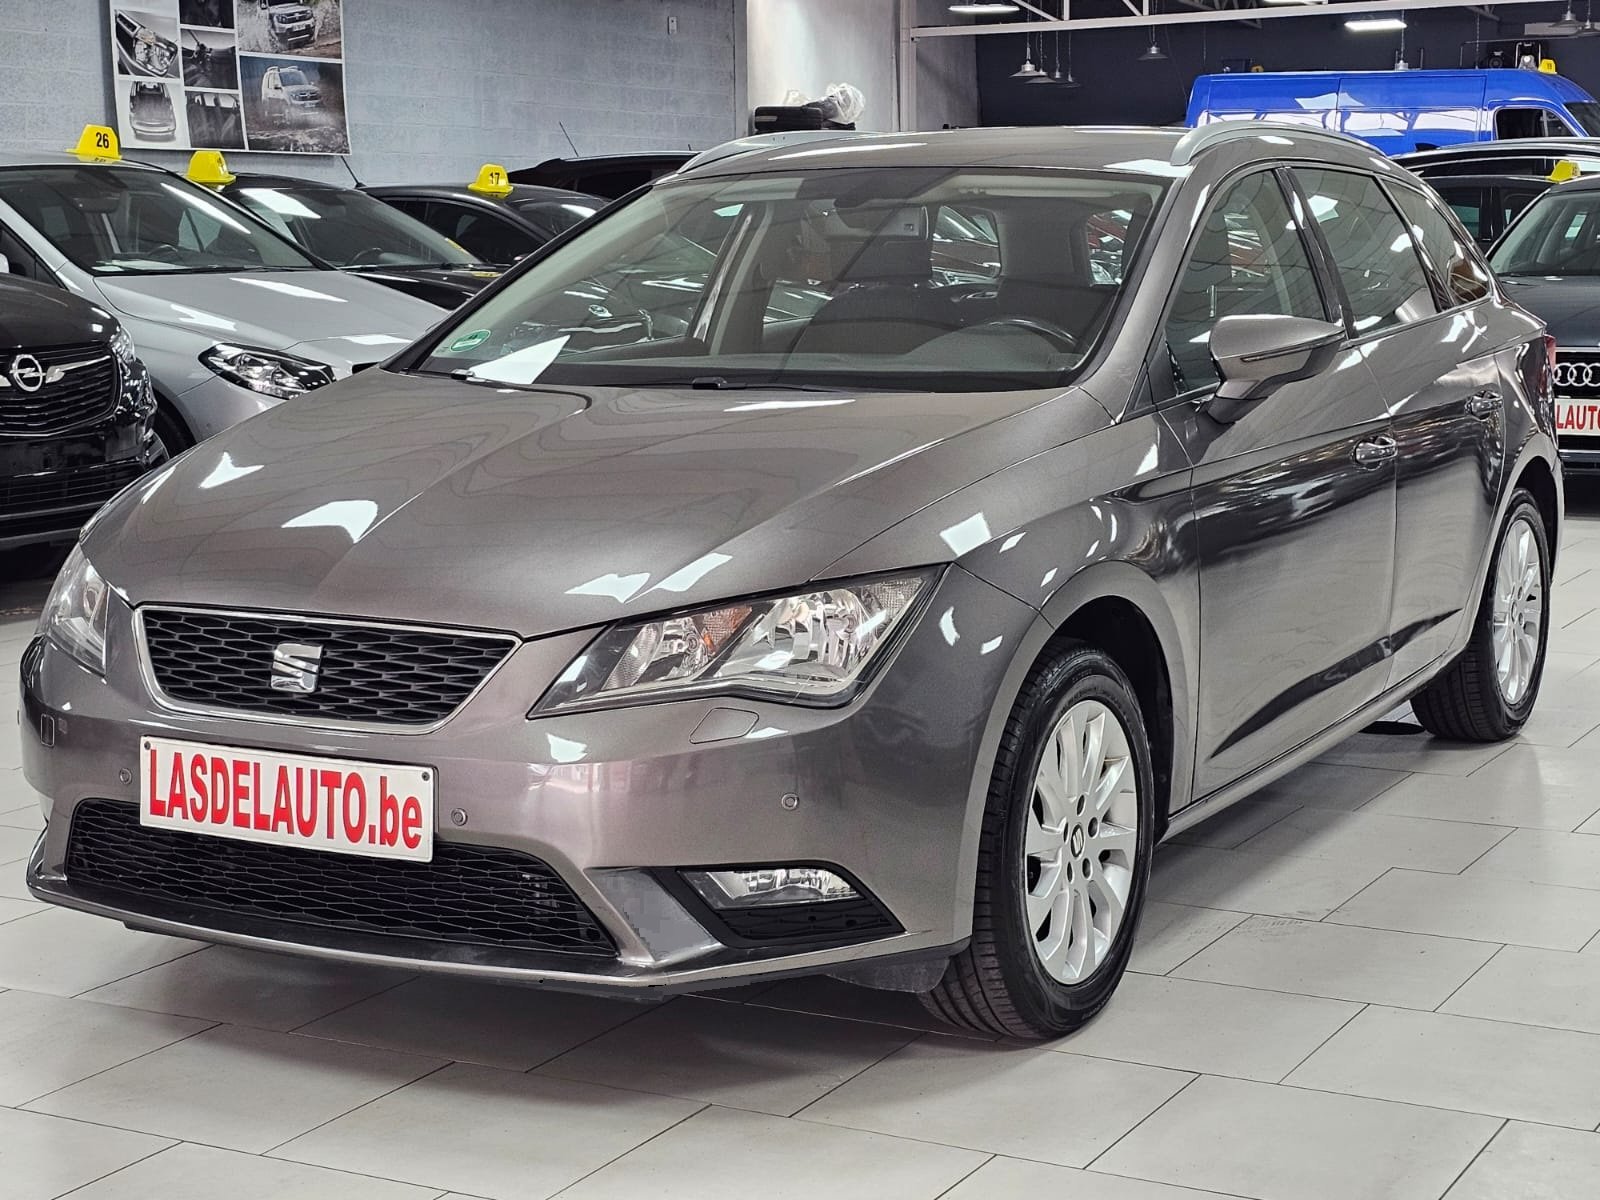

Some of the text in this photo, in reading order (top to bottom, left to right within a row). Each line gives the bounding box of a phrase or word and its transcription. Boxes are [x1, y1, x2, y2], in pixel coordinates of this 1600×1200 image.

[96, 132, 109, 149] 26
[489, 172, 500, 184] 17
[1556, 404, 1600, 430] LAUT
[149, 748, 423, 850] LASDELAUTO.be
